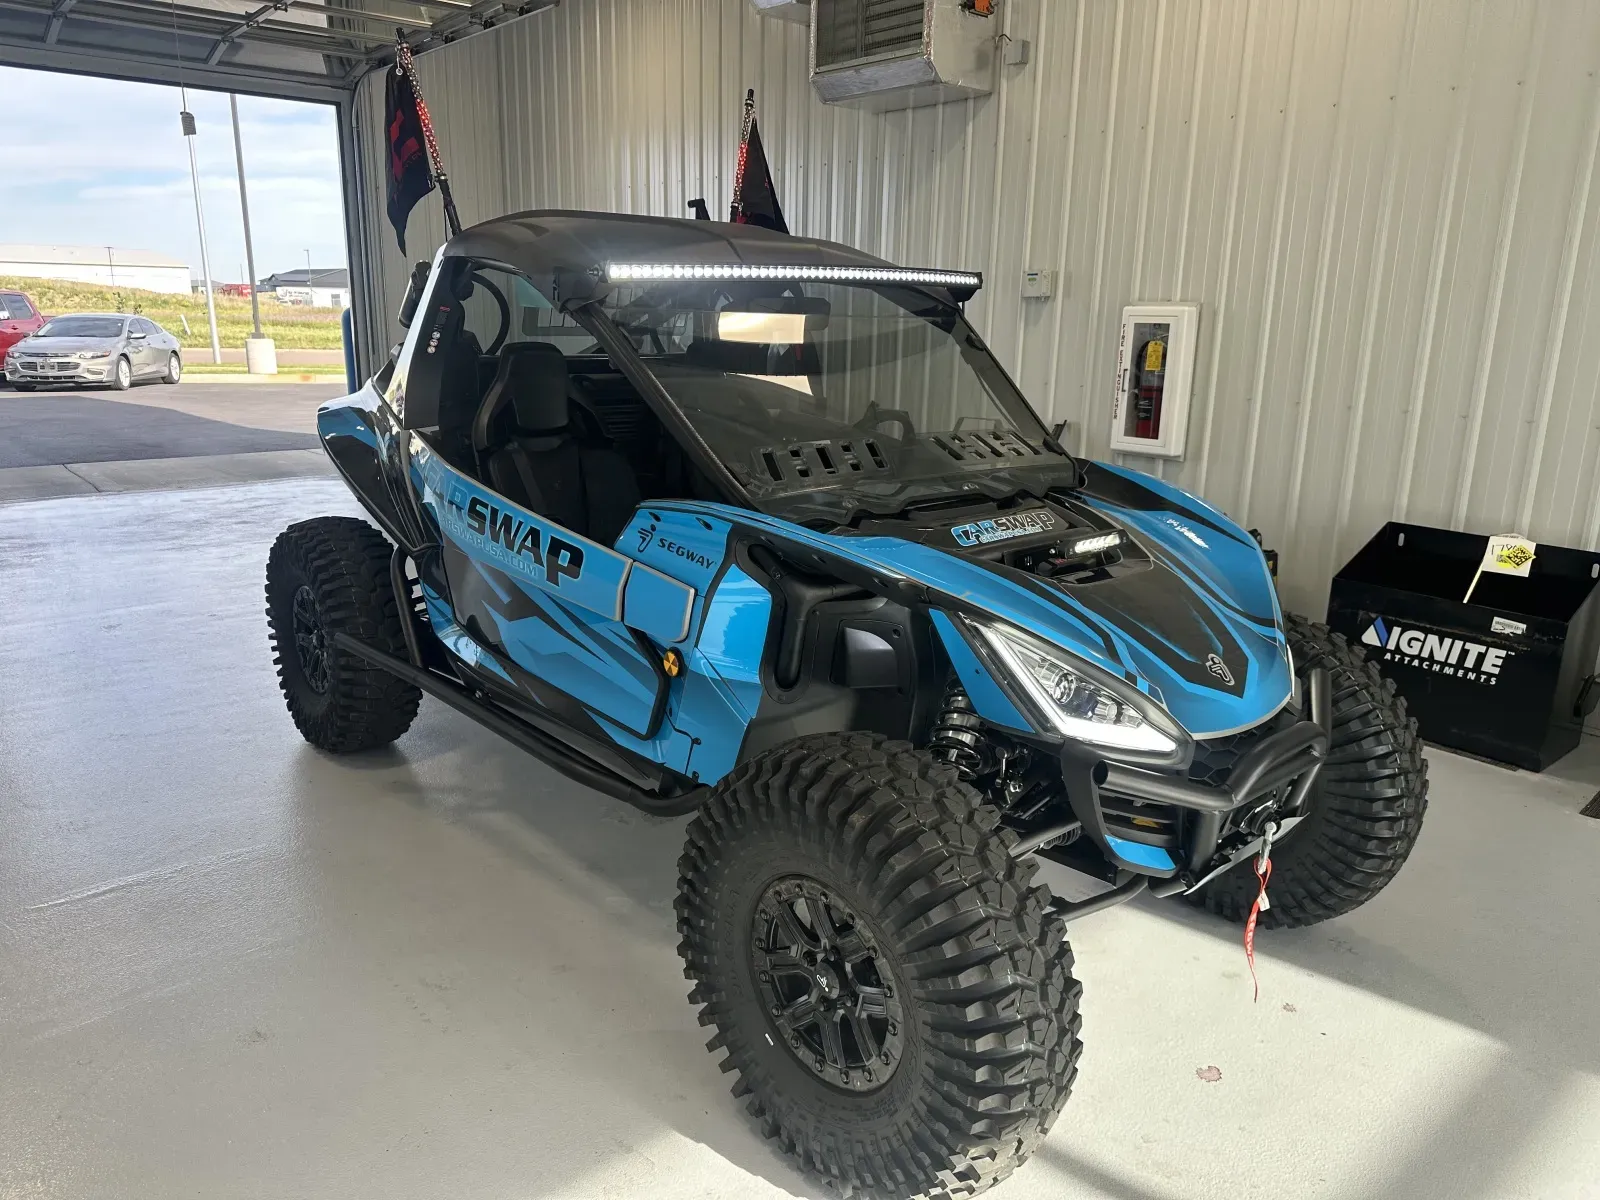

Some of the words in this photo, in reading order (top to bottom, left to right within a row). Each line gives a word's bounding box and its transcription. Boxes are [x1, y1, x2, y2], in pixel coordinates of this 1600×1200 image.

[440, 513, 538, 578] ARSWAPUSA.COM
[951, 512, 1055, 546] CARSWAP
[657, 537, 715, 570] SEGWAY
[1386, 627, 1507, 674] IGNITE
[1384, 653, 1497, 685] ATTACHMENTS
